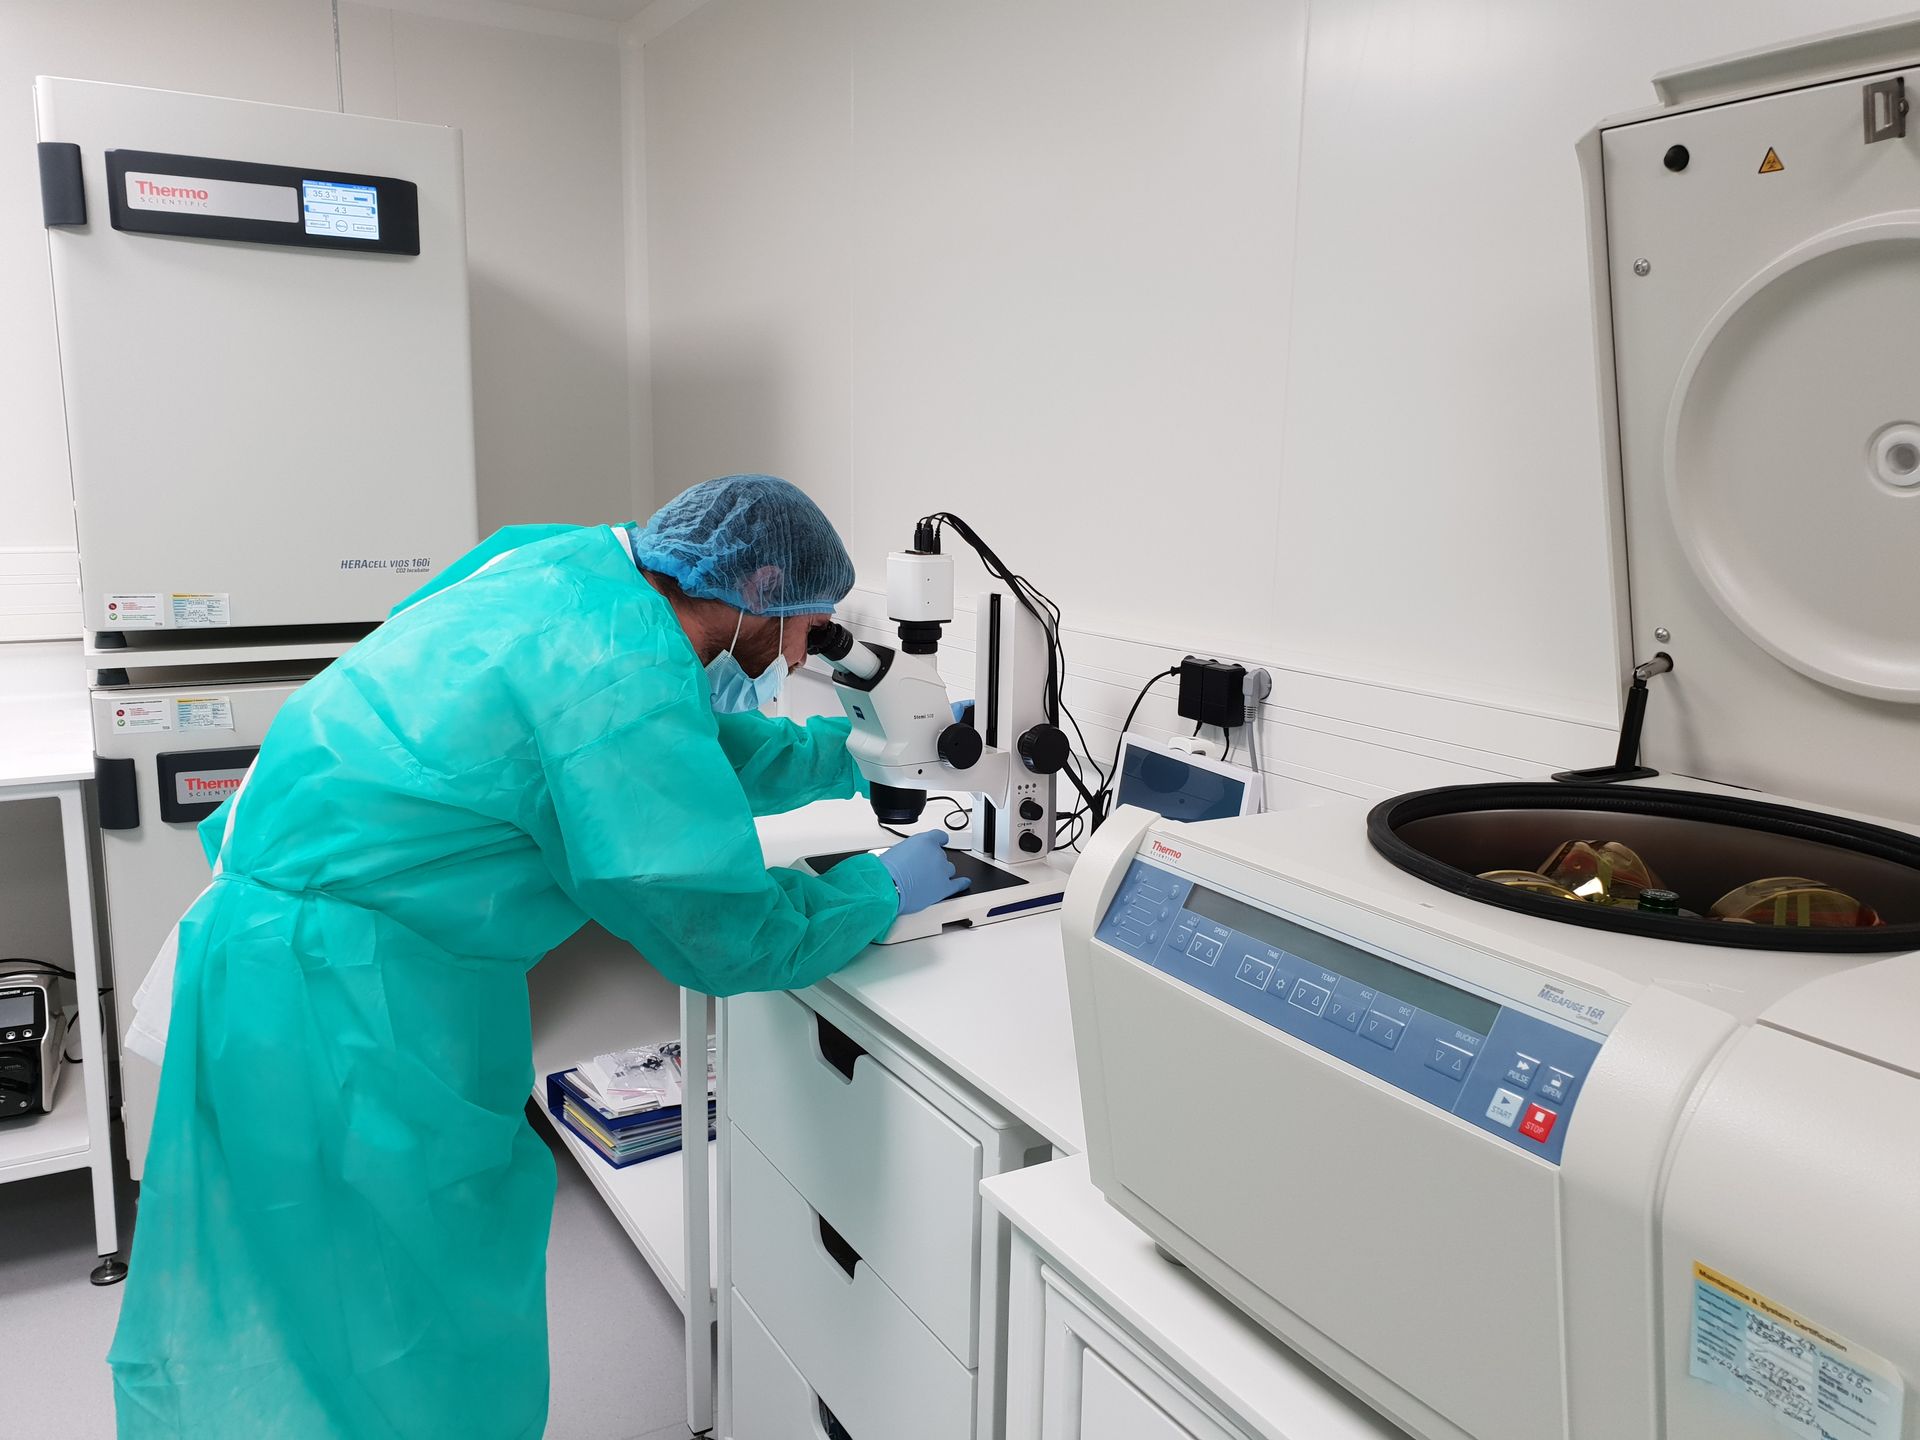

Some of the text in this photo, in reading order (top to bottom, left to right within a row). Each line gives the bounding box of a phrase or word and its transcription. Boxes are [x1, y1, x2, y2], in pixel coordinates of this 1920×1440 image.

[135, 180, 209, 200] Thermo
[139, 196, 208, 209] SCIENTIFIC
[389, 559, 410, 568] VIOS
[411, 557, 431, 567] 160i
[1151, 840, 1182, 859] Thermo
[1213, 926, 1229, 938] SPEED
[1267, 949, 1280, 960] TIME
[1320, 972, 1337, 983] TEMP
[1359, 990, 1373, 1000] ACC
[1398, 1006, 1412, 1017] DEC
[1585, 1006, 1605, 1020] 16R
[1455, 1030, 1481, 1046] BUCKET
[1506, 1069, 1530, 1084] PULSE
[1542, 1085, 1562, 1100] OPEN
[1490, 1104, 1513, 1120] START
[1525, 1121, 1545, 1135] STOP
